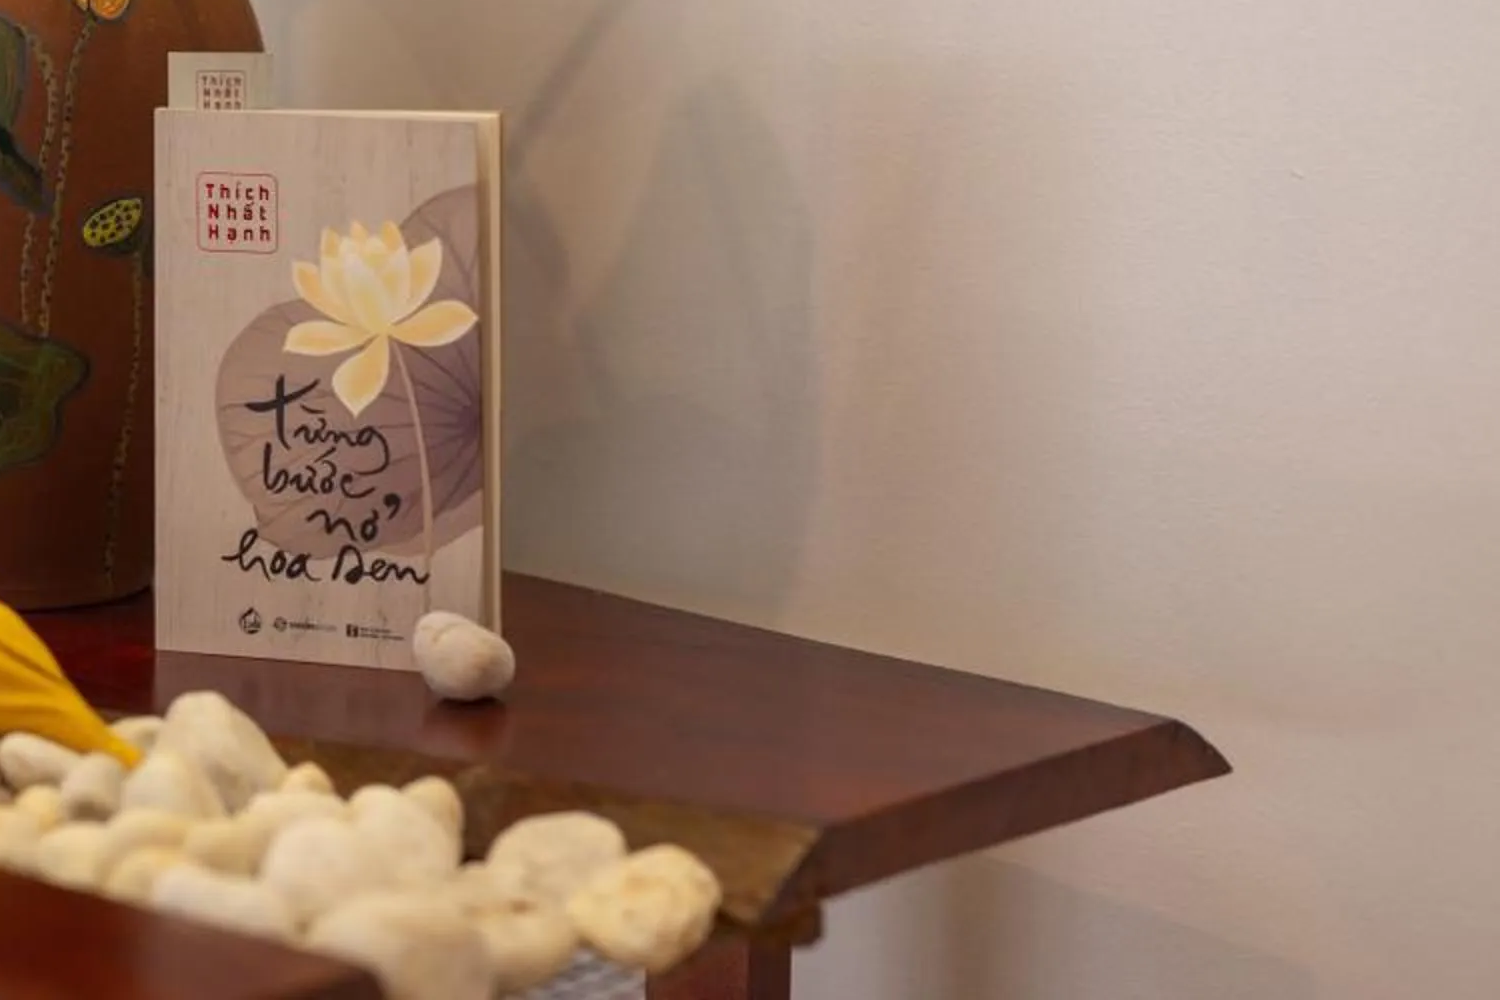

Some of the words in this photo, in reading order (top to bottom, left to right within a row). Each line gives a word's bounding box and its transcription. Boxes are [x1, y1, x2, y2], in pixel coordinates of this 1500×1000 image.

[205, 181, 269, 201] Thích
[208, 201, 267, 221] Nhất
[208, 224, 270, 244] Hạnh
[220, 528, 322, 582] hoa
